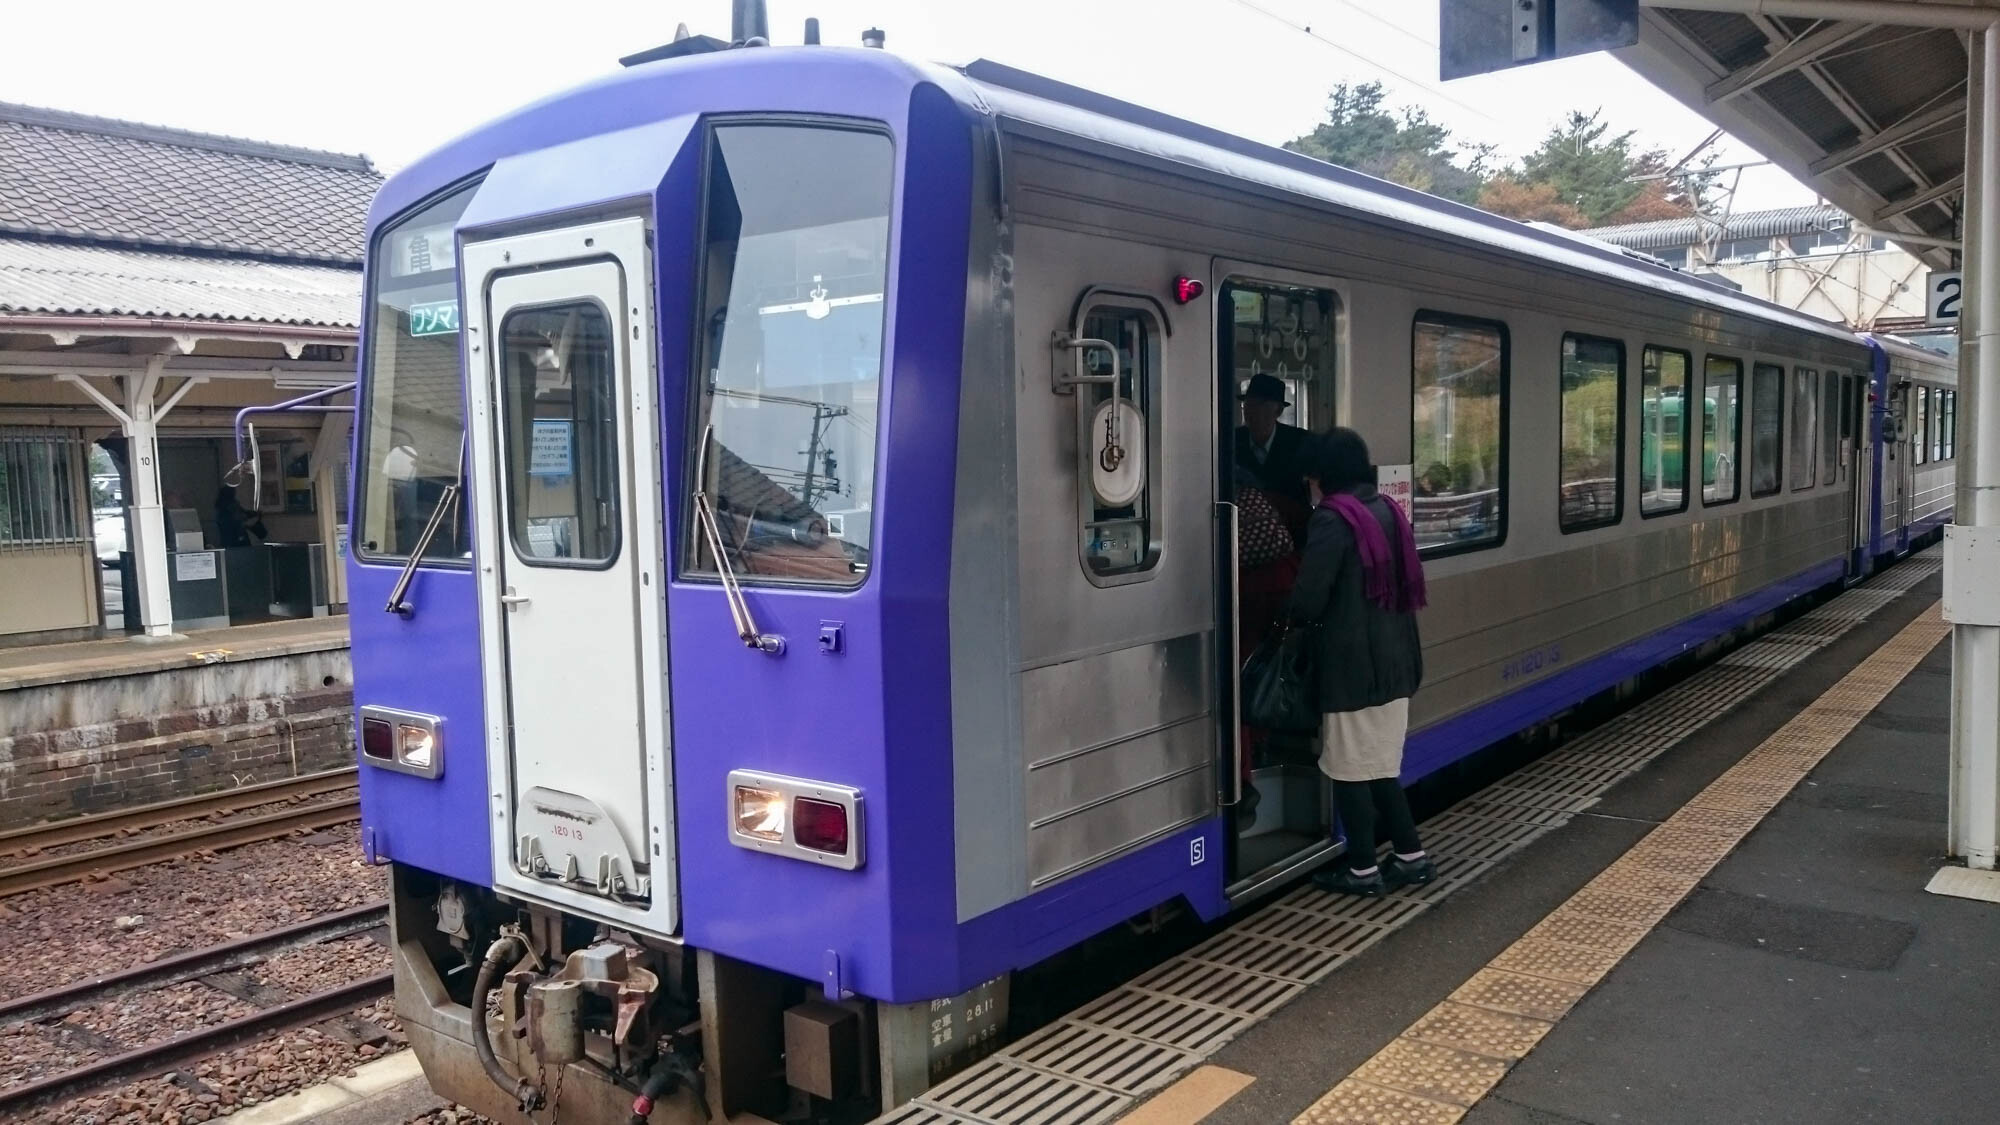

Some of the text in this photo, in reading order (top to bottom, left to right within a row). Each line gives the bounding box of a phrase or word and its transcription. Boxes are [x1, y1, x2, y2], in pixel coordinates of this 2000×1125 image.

[1936, 277, 1962, 318] 2
[140, 456, 150, 466] 10
[571, 829, 583, 841] 13
